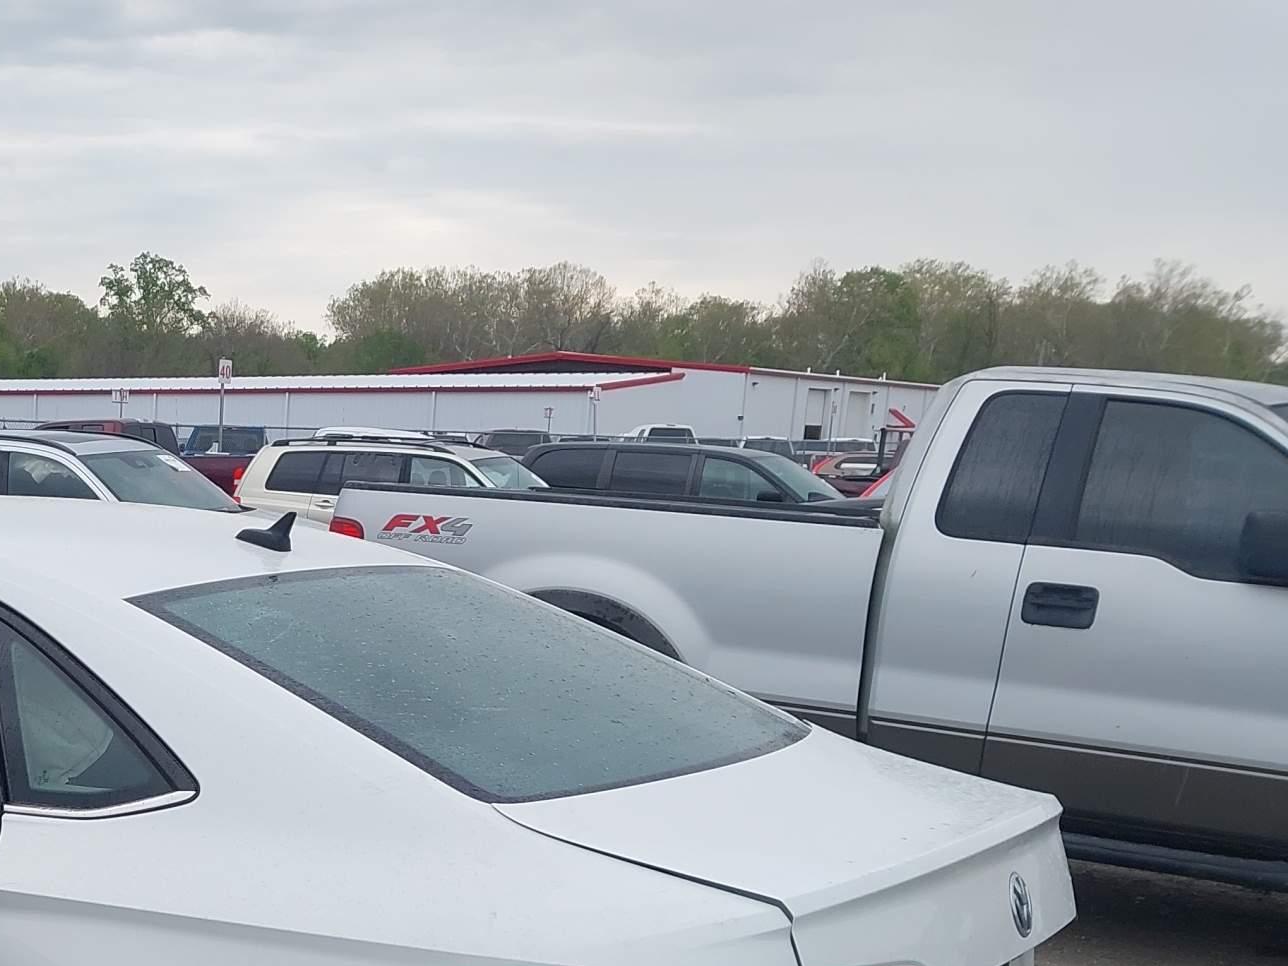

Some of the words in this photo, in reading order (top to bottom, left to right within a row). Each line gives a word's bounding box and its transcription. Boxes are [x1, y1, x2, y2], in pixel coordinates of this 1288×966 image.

[219, 365, 231, 379] 40
[382, 514, 473, 536] FX4
[414, 534, 467, 545] ROAD
